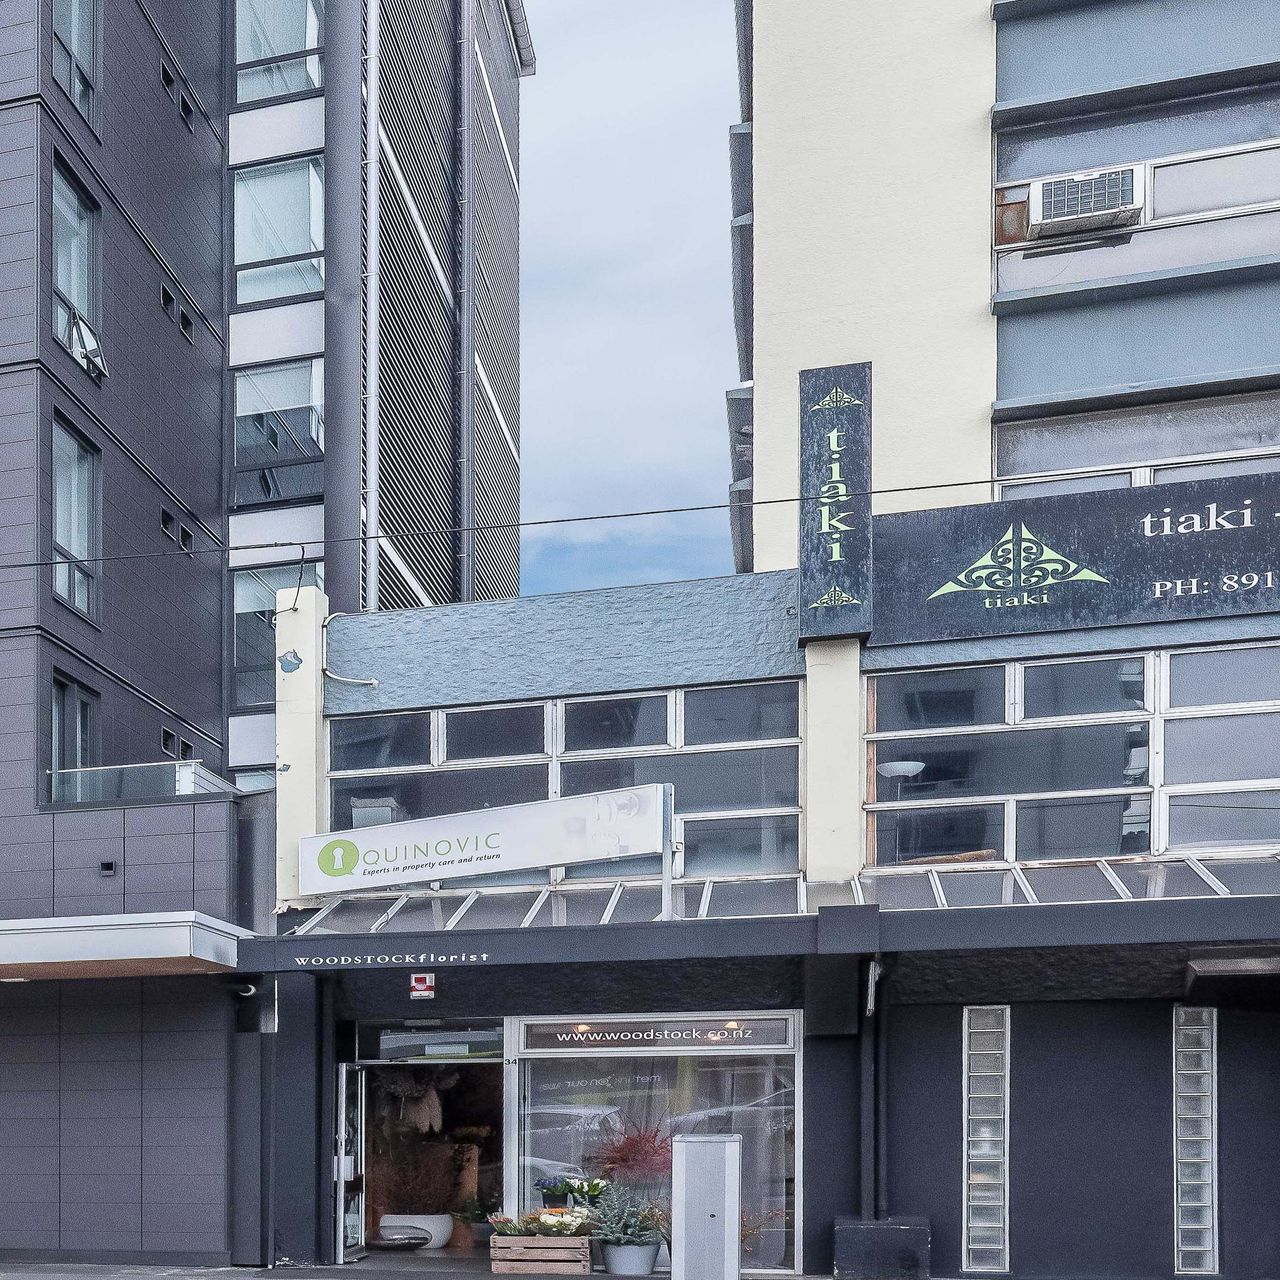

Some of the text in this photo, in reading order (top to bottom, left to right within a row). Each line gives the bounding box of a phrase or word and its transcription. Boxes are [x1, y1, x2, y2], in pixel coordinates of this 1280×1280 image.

[817, 427, 856, 562] tiaki
[1140, 499, 1255, 538] tiaki
[983, 590, 1050, 609] tiaki
[1153, 578, 1209, 598] PH:
[362, 832, 501, 866] QUINOVIC
[362, 866, 390, 876] Experts
[402, 860, 436, 872] property
[438, 859, 455, 867] care
[458, 855, 473, 864] and
[475, 853, 501, 862] return
[556, 1028, 753, 1042] www.woodstock.co.nz
